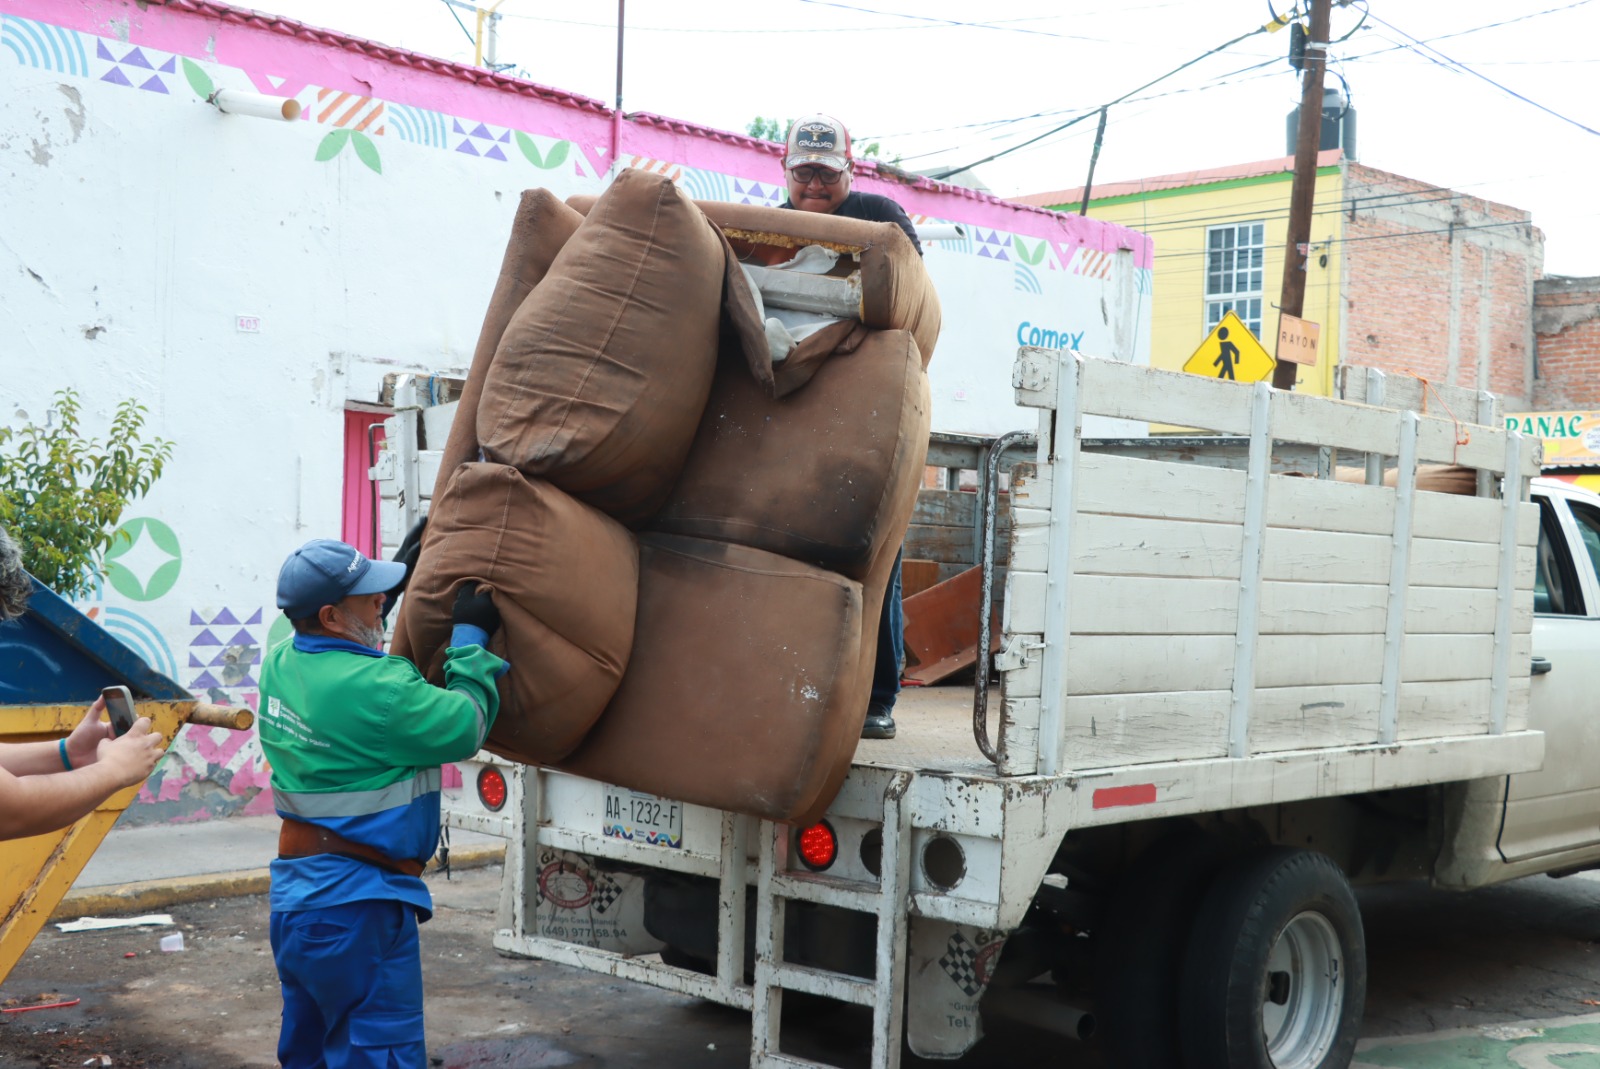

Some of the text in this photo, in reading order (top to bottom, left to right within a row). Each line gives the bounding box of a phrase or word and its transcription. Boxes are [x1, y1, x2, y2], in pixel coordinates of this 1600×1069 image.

[1017, 321, 1085, 351] Comex
[1281, 331, 1316, 350] RAYON
[606, 795, 678, 829] AA-1232-F
[946, 1015, 972, 1028] Tel.
